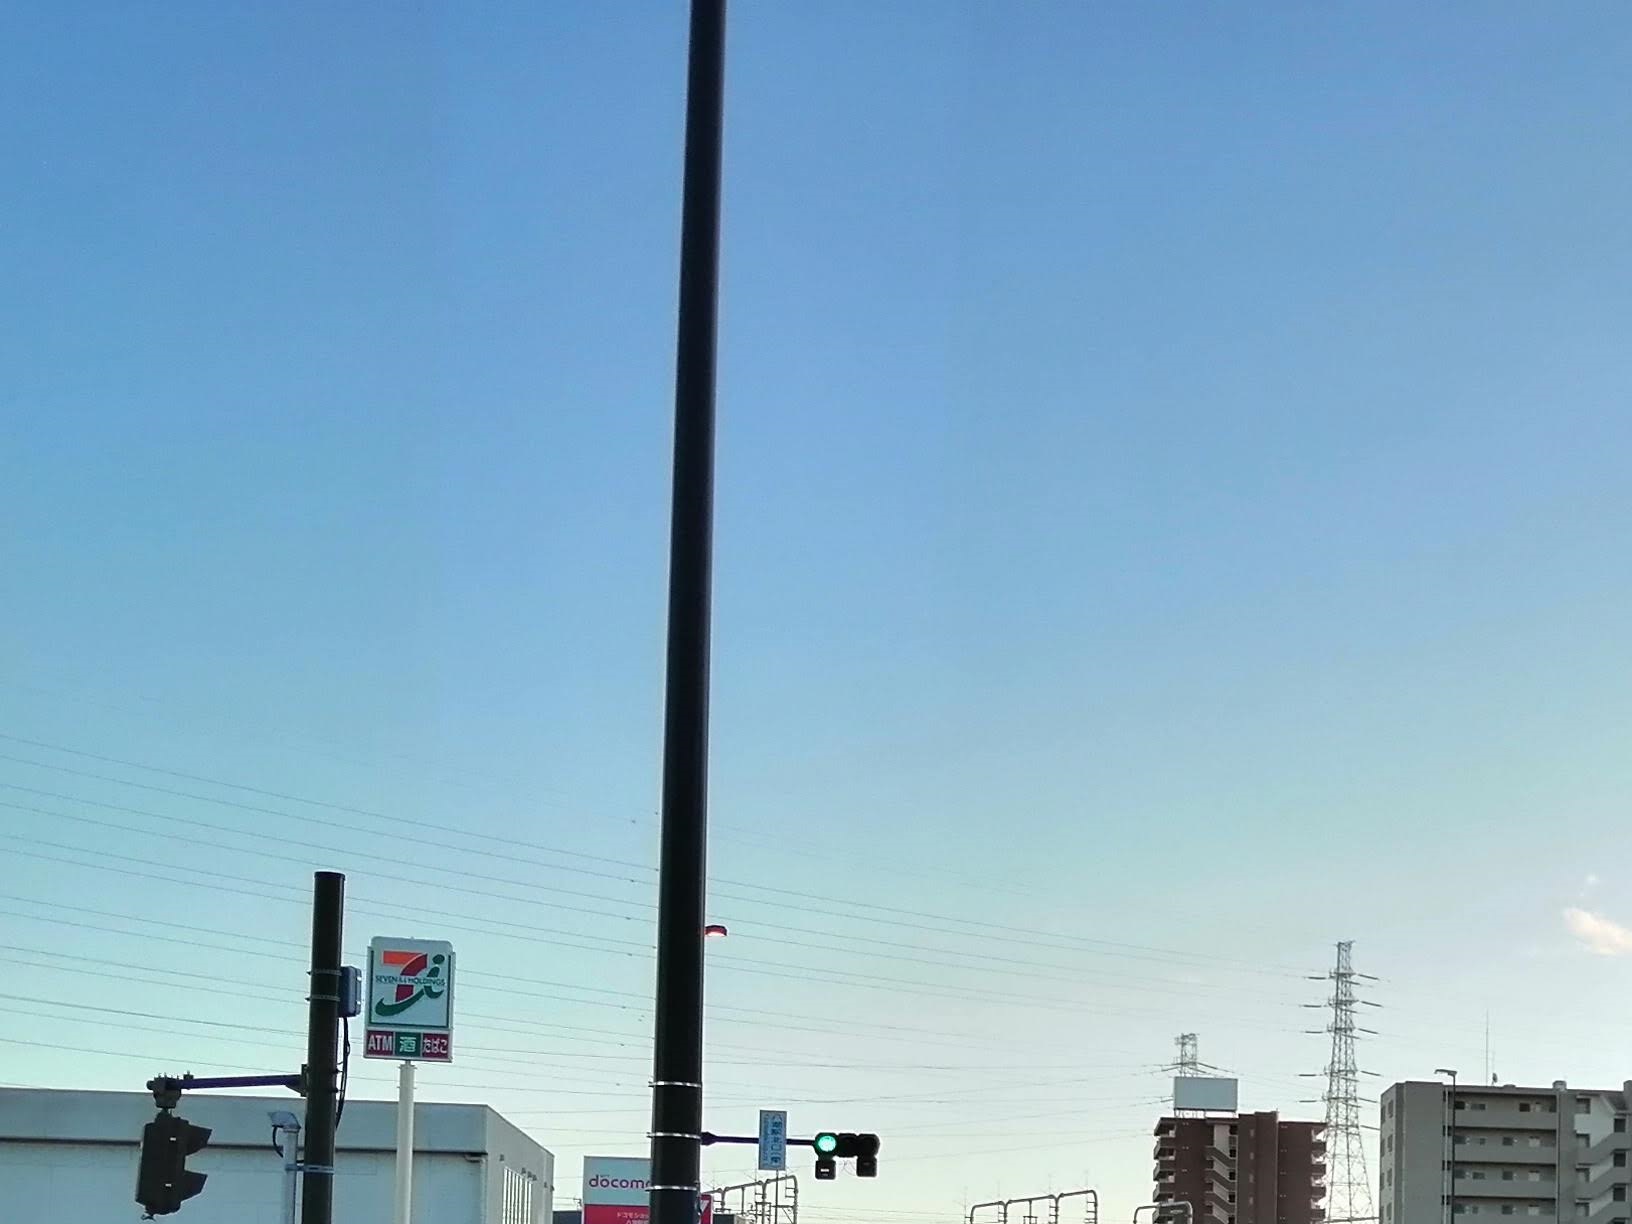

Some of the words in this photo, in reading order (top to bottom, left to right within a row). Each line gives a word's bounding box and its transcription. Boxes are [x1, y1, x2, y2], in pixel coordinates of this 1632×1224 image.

[368, 1035, 393, 1052] ATM
[399, 1036, 417, 1053] 酒
[423, 1037, 448, 1054] たばこ
